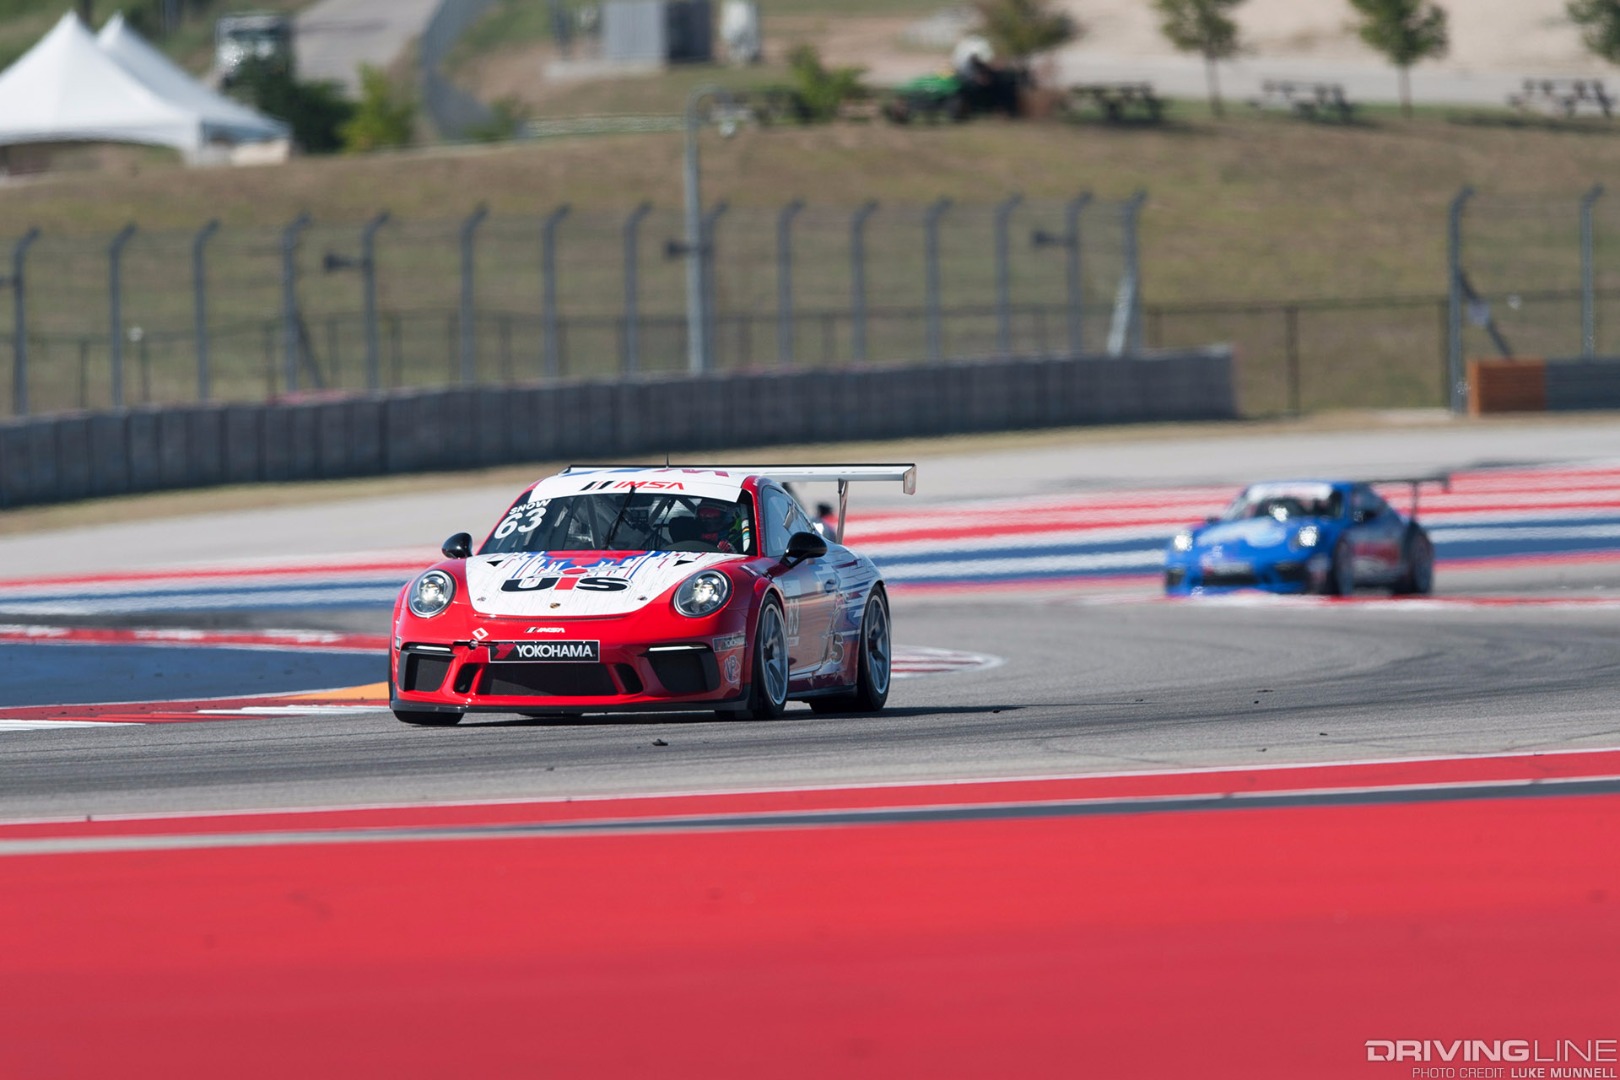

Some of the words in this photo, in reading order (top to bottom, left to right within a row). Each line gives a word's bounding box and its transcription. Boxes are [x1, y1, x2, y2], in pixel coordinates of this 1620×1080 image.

[613, 480, 685, 491] IMSA
[508, 498, 552, 515] SNOW
[494, 507, 547, 539] 63
[516, 644, 593, 658] YOKOHAMA
